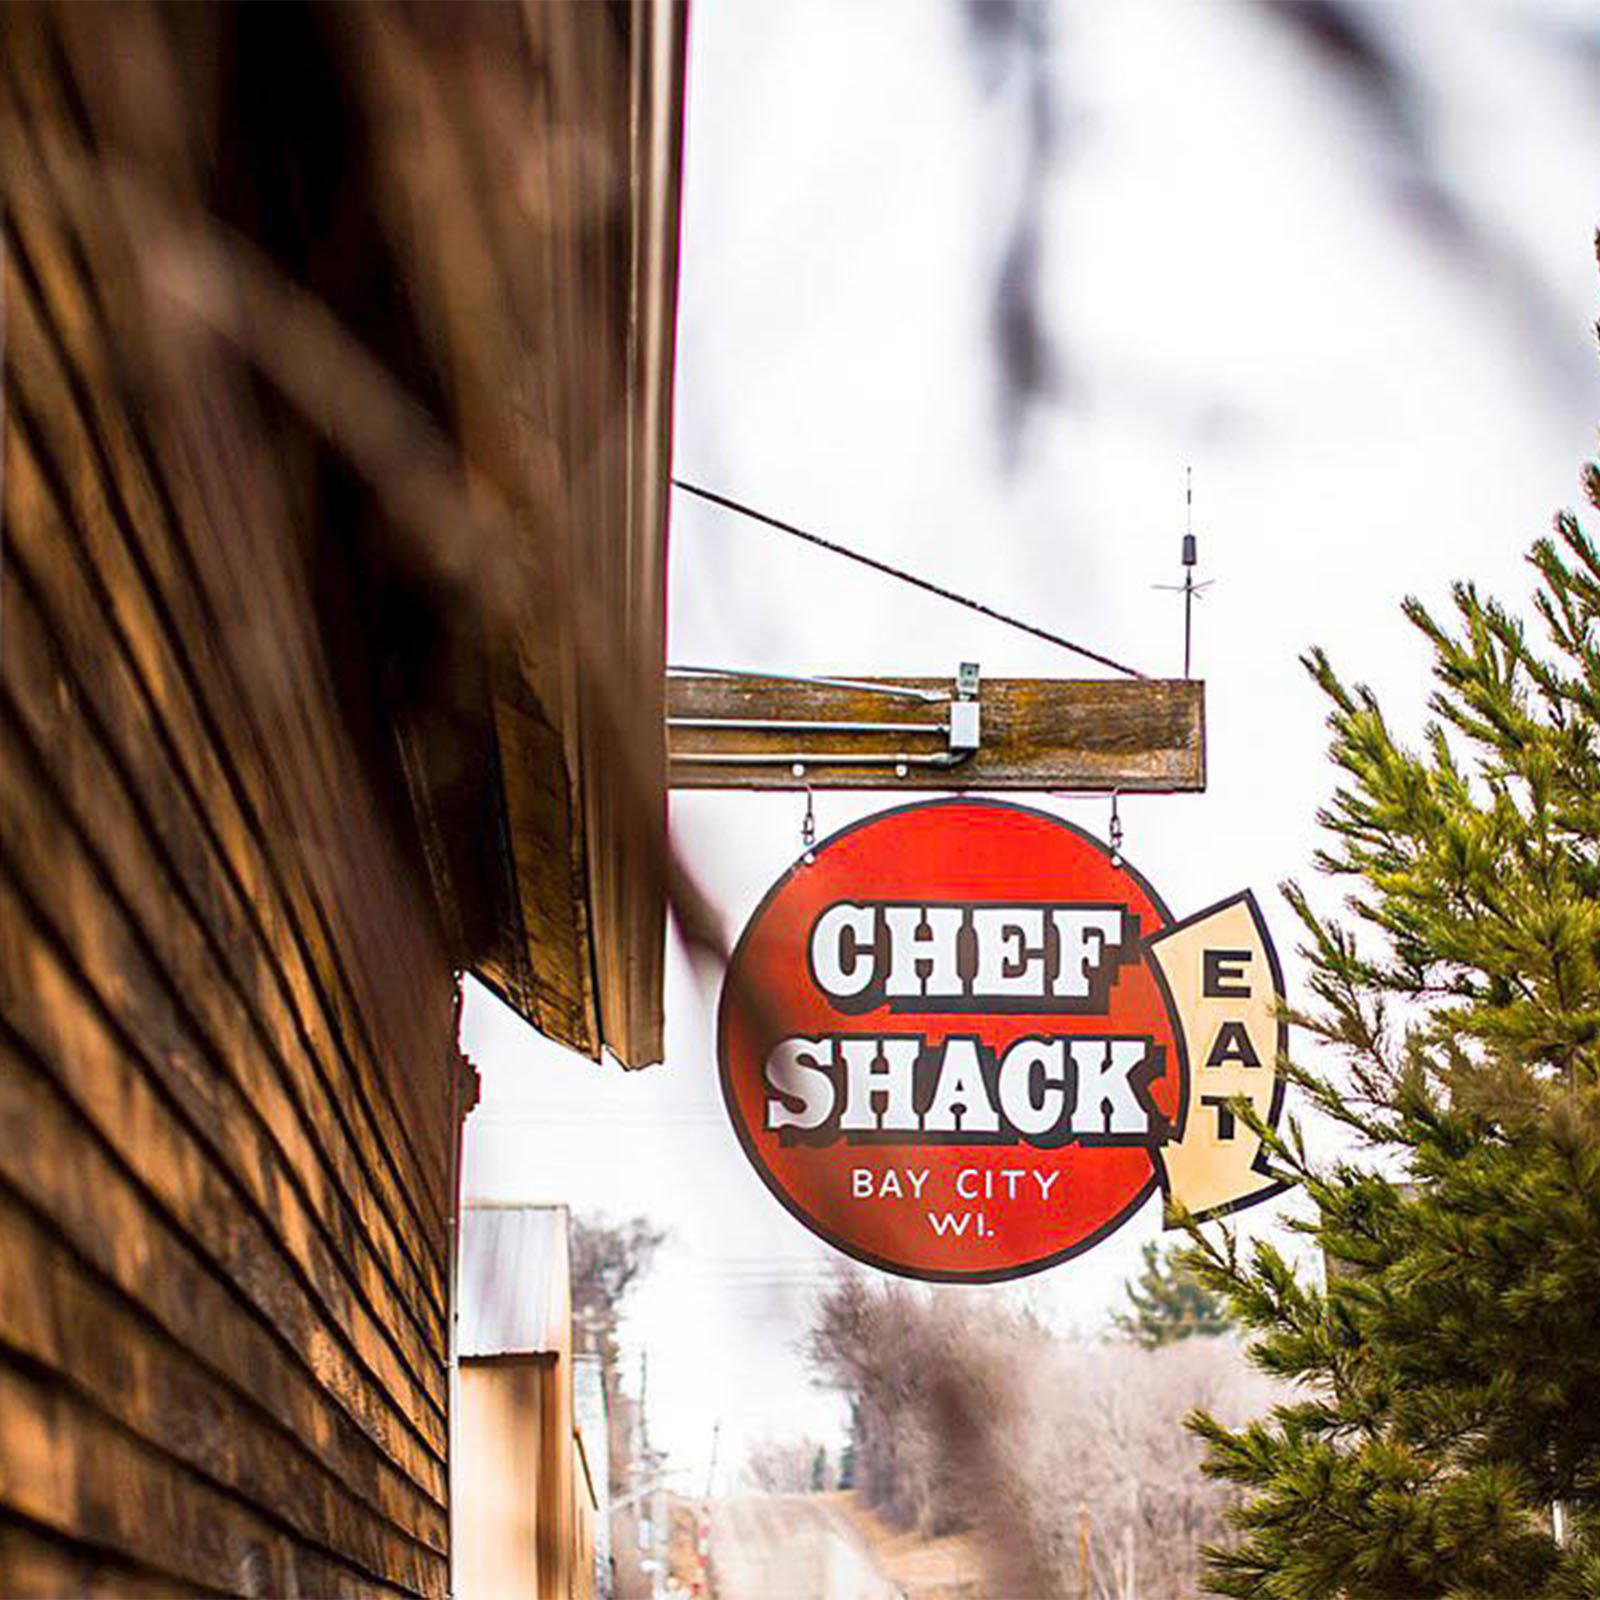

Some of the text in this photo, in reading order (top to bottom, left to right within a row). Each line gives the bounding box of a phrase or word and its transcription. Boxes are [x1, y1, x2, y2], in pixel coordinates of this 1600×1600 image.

[809, 901, 1125, 999] CHEF
[764, 1036, 1151, 1133] SHACK
[1201, 948, 1261, 1141] EAT
[851, 1168, 1061, 1200] BAY CITY
[928, 1211, 995, 1238] WI.
